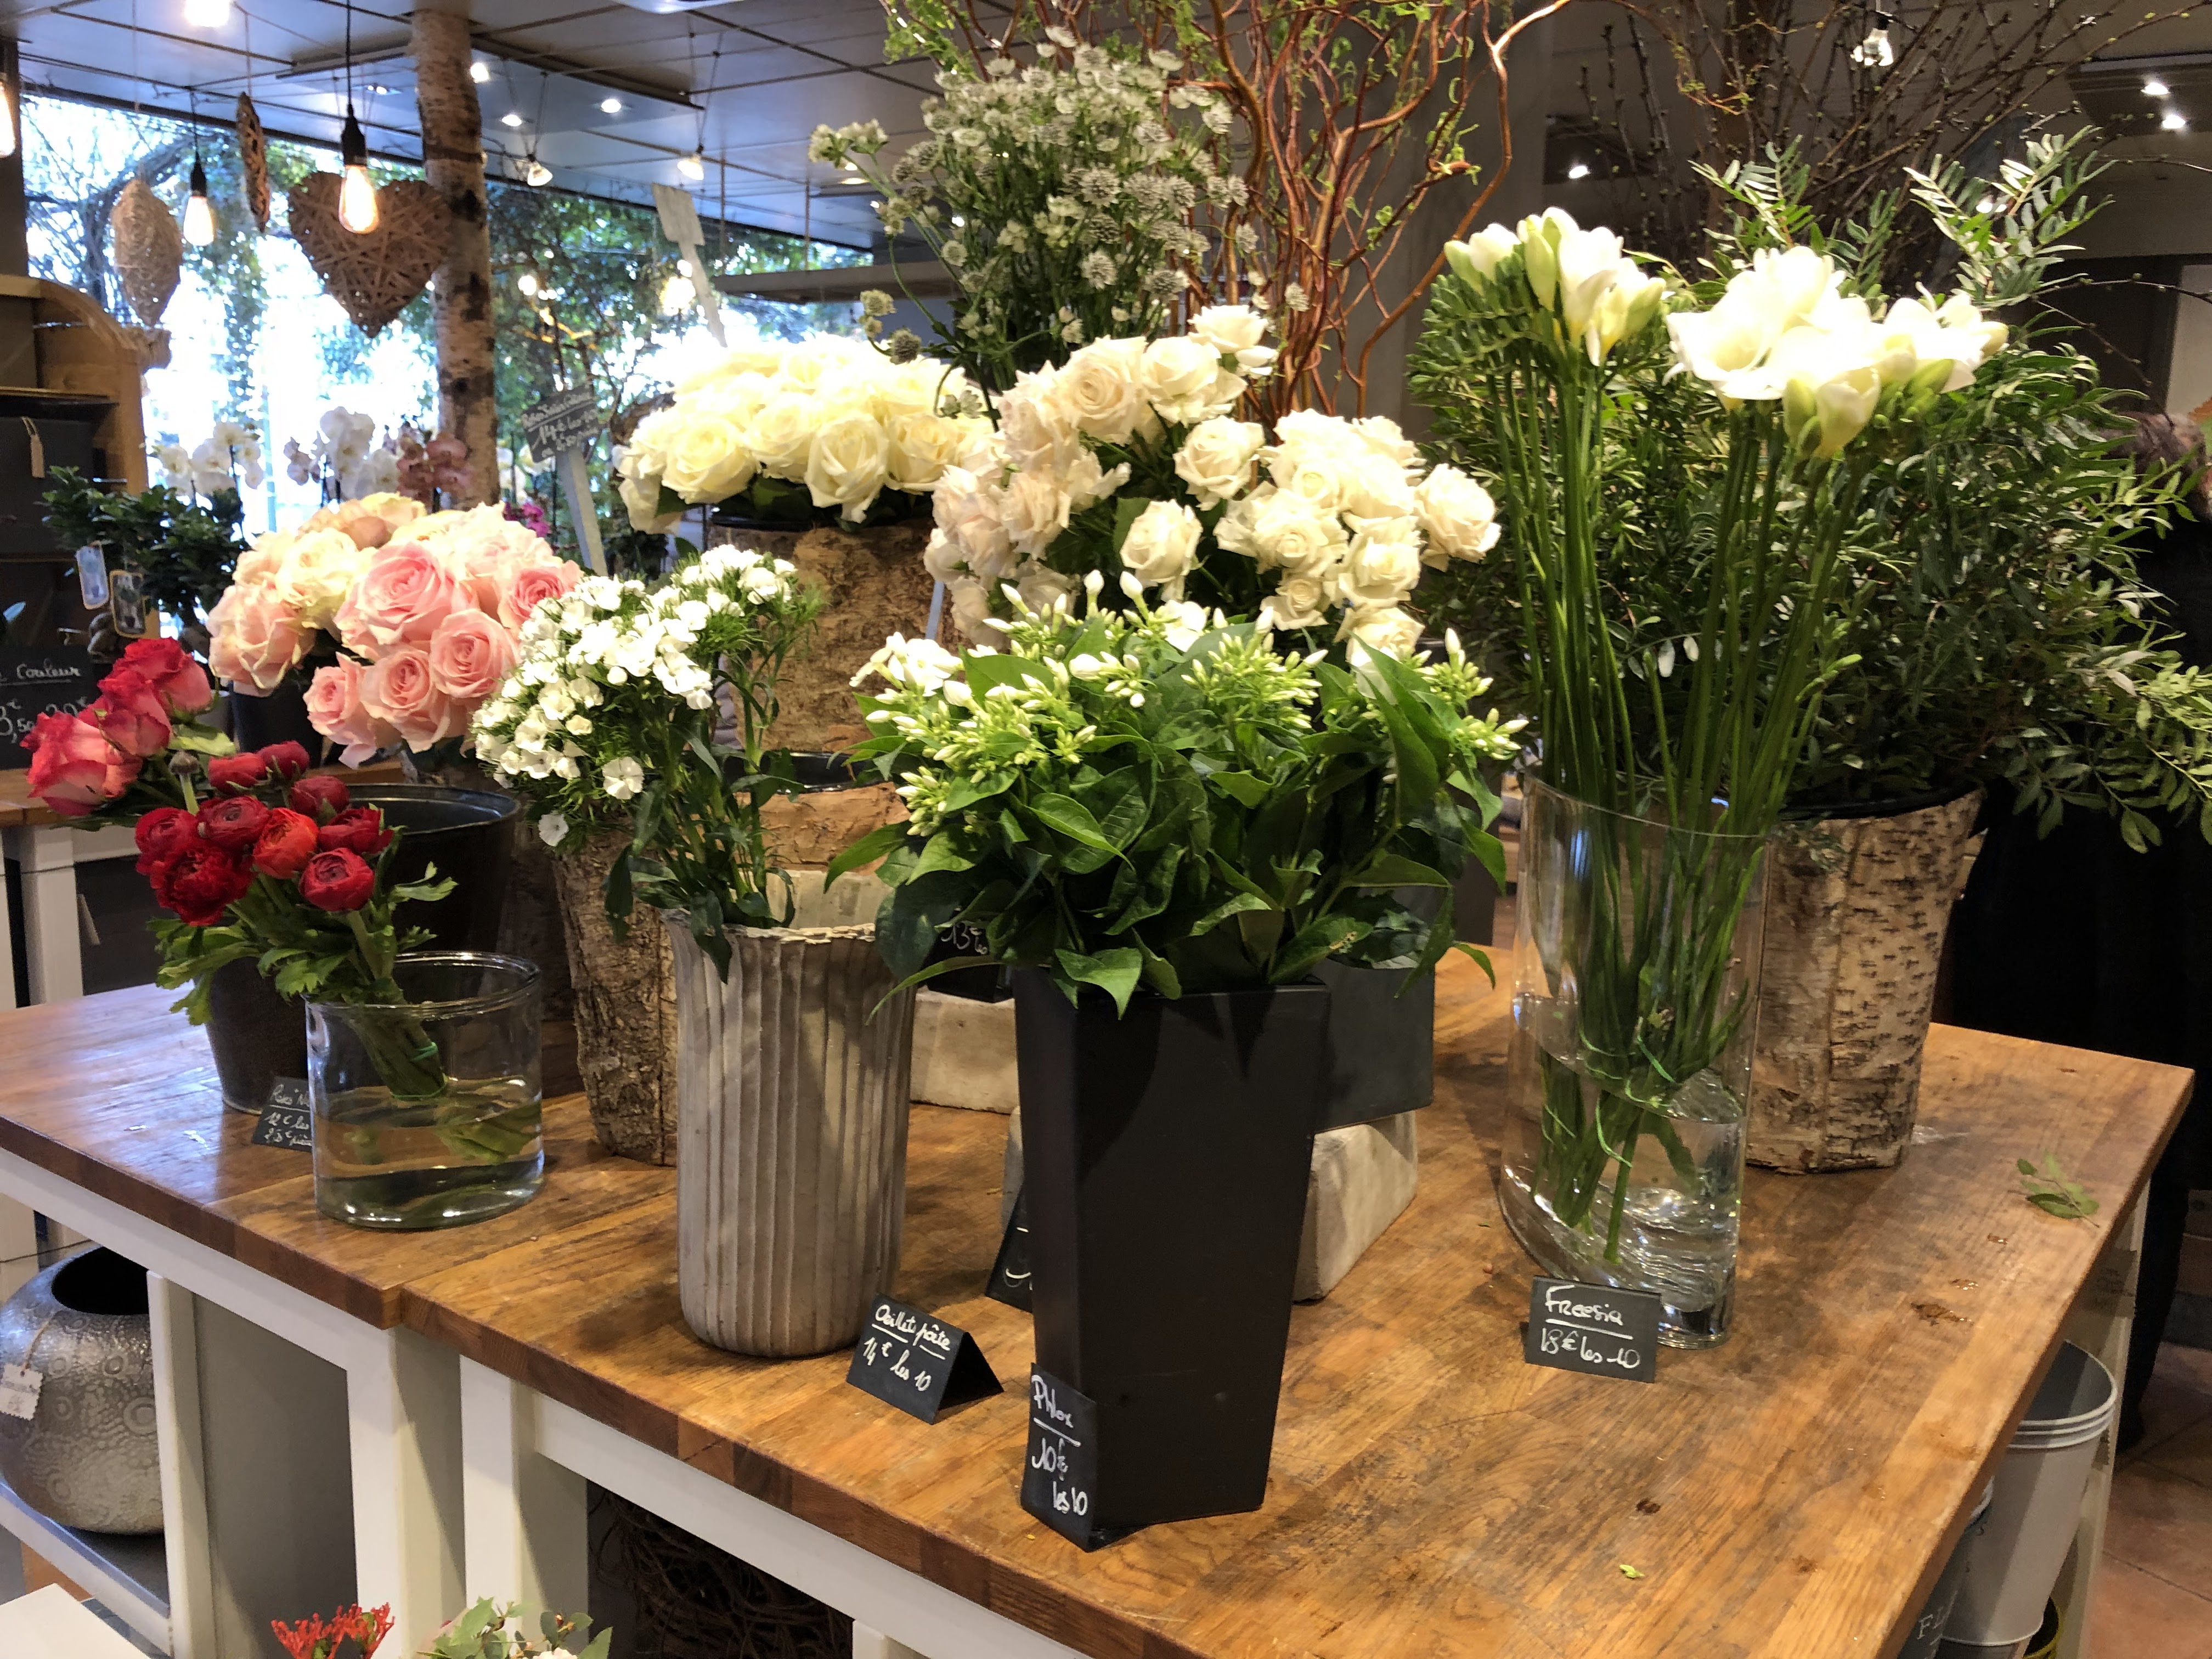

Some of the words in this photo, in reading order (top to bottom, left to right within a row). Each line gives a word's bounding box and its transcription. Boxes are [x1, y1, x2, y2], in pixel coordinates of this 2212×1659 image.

[16, 658, 82, 679] Couleur
[889, 1349, 910, 1380] les
[914, 1370, 932, 1391] 10
